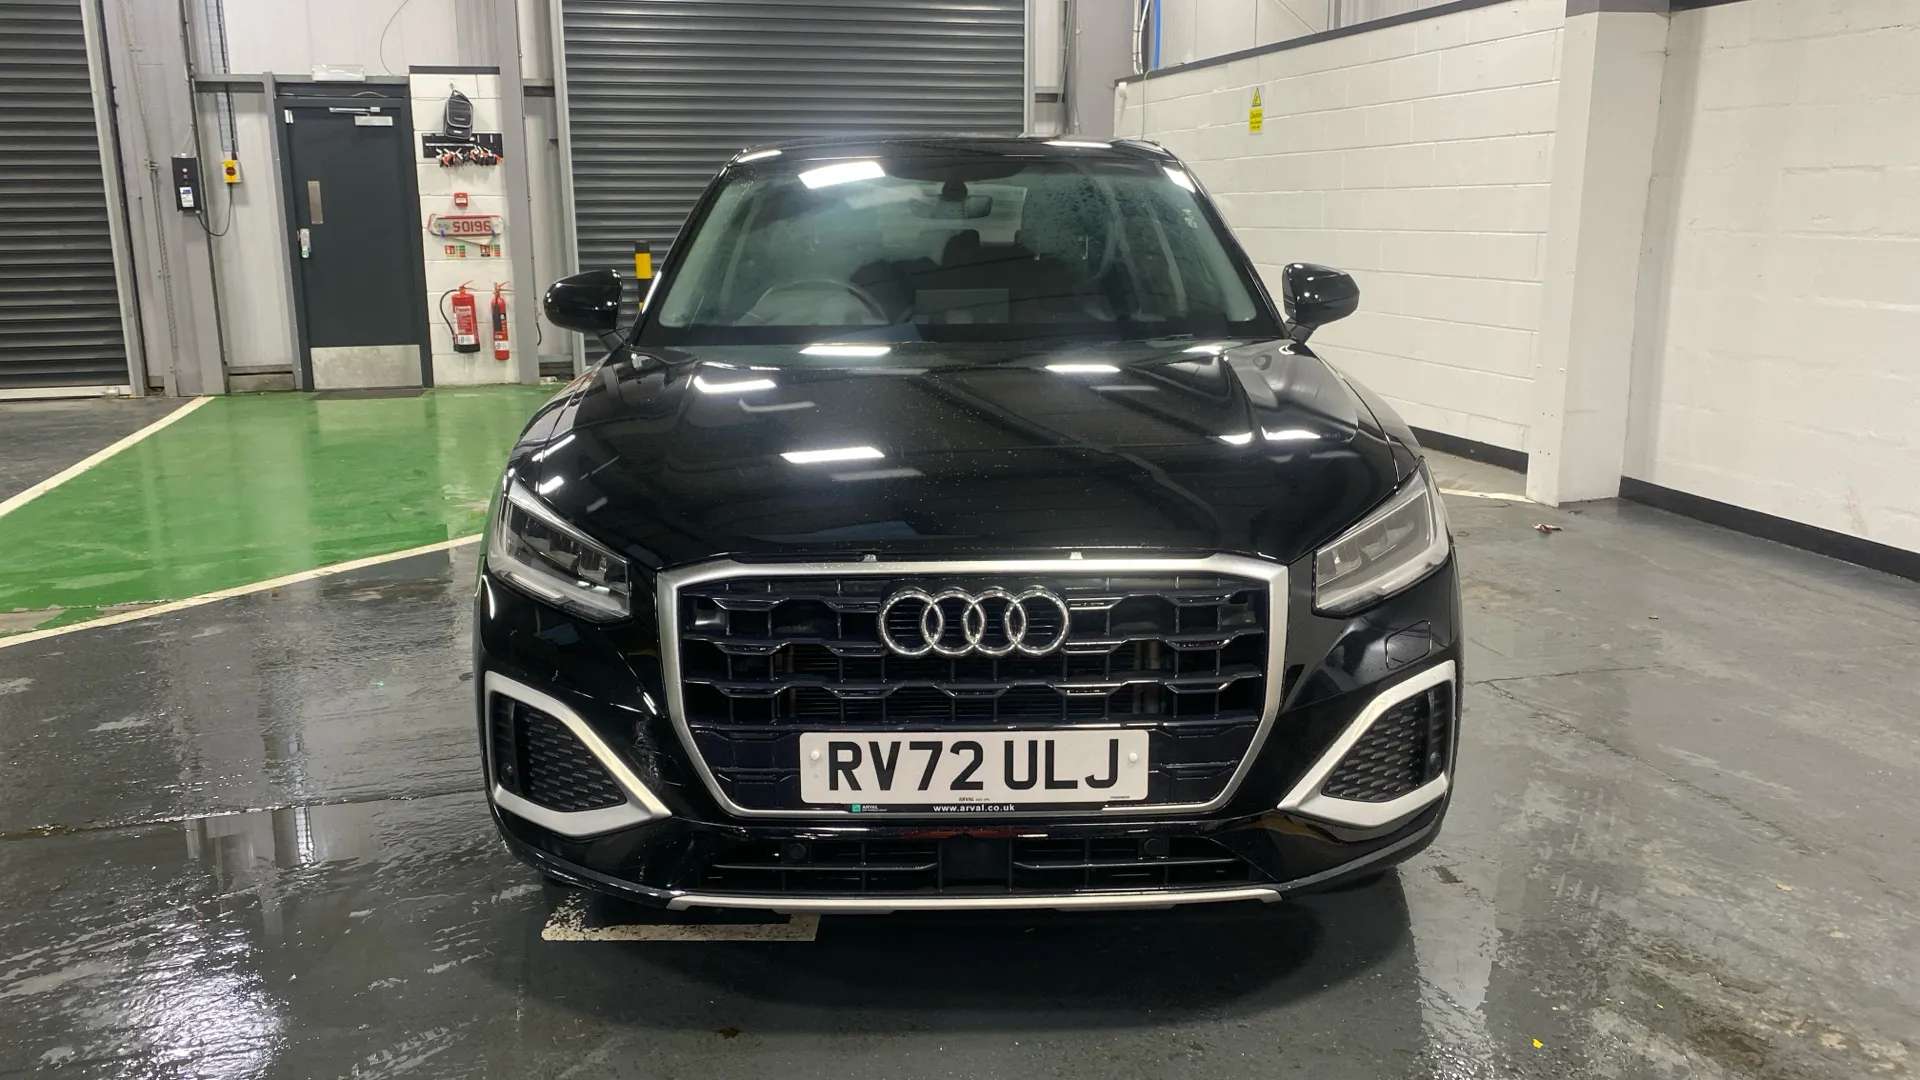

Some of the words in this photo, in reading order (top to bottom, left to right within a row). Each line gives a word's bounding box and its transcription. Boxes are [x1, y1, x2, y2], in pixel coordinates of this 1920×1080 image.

[828, 740, 984, 791] RV72
[1004, 738, 1119, 790] ULJ
[933, 804, 1015, 812] www.arval.co.uk
